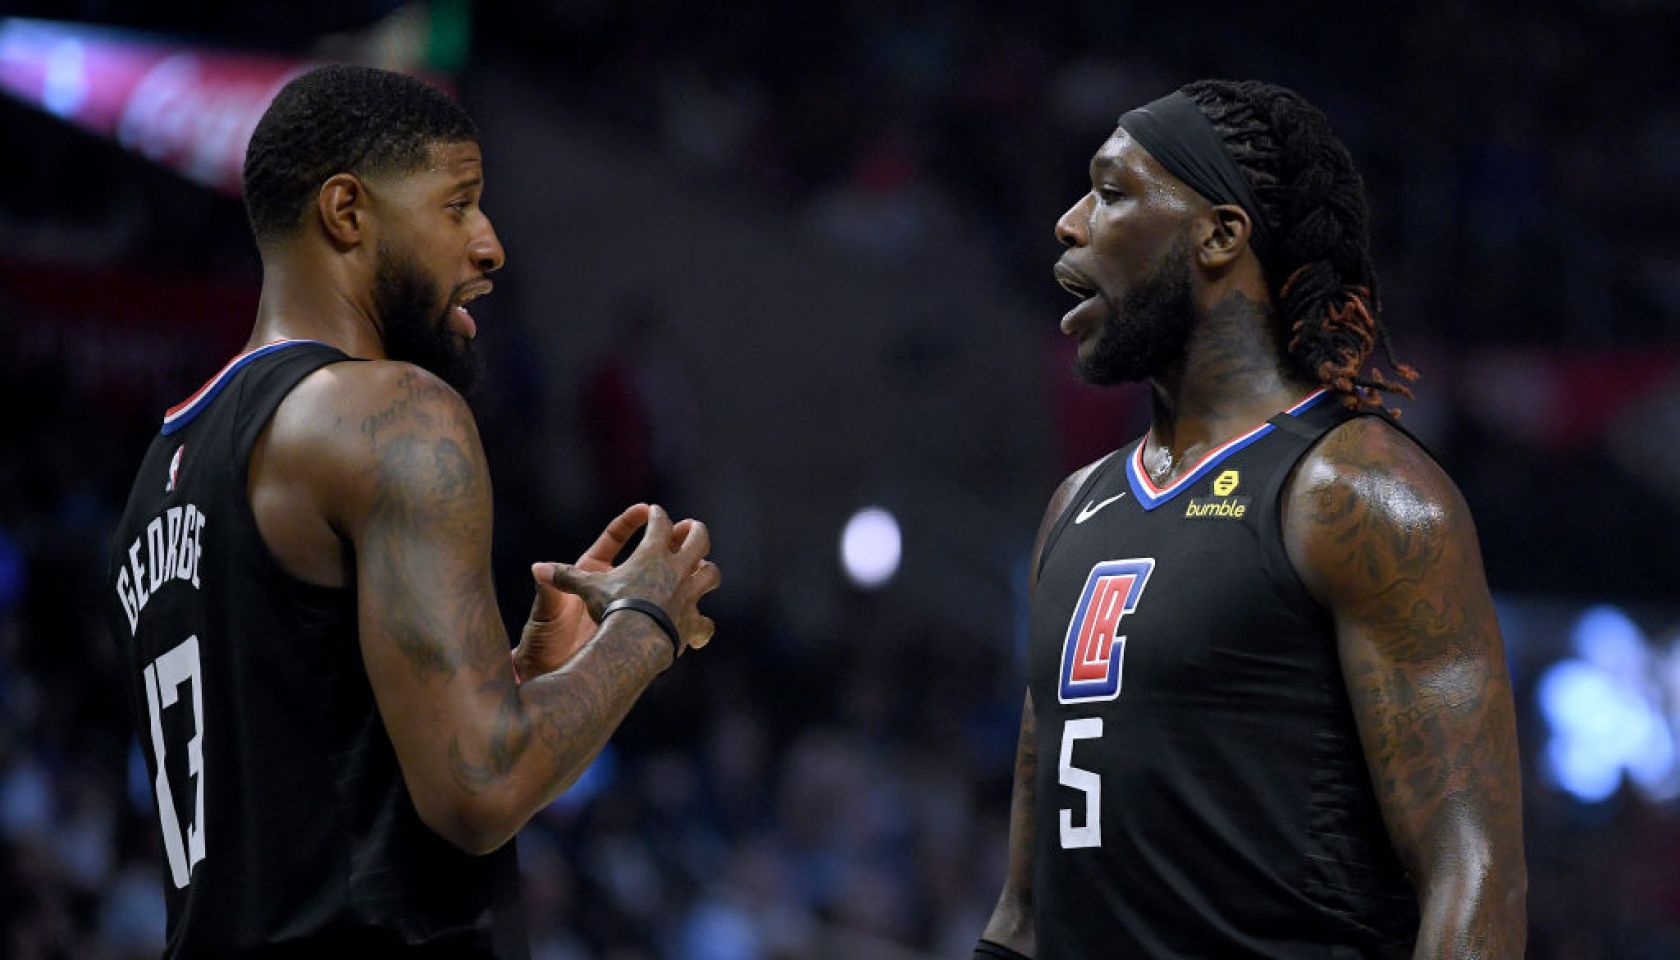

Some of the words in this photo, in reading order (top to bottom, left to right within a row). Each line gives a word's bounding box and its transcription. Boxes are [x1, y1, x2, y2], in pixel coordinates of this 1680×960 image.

[116, 503, 206, 637] GEORGE
[1185, 499, 1246, 518] bumble
[143, 634, 206, 889] 13
[1058, 717, 1104, 849] 5
